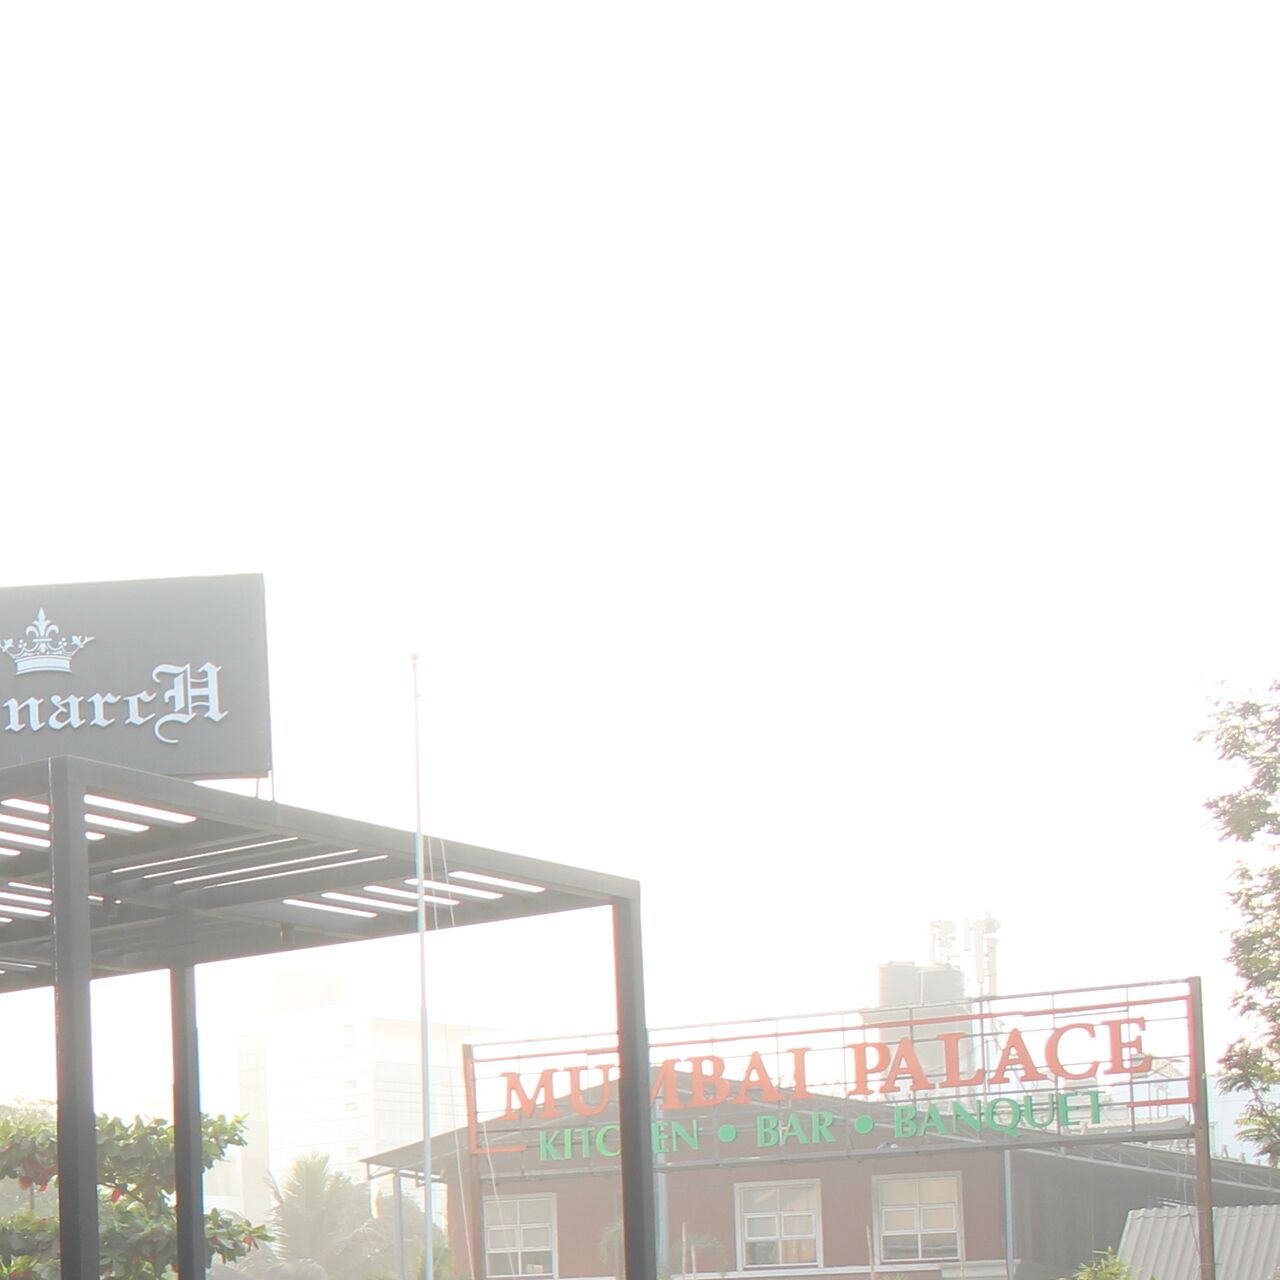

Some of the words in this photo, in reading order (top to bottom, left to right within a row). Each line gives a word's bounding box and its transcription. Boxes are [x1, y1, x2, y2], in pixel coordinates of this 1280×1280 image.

[846, 1016, 1153, 1097] PALACE
[539, 1118, 700, 1162] KITCEN
[756, 1110, 837, 1149] BAR
[893, 1089, 1107, 1139] BANQUET
